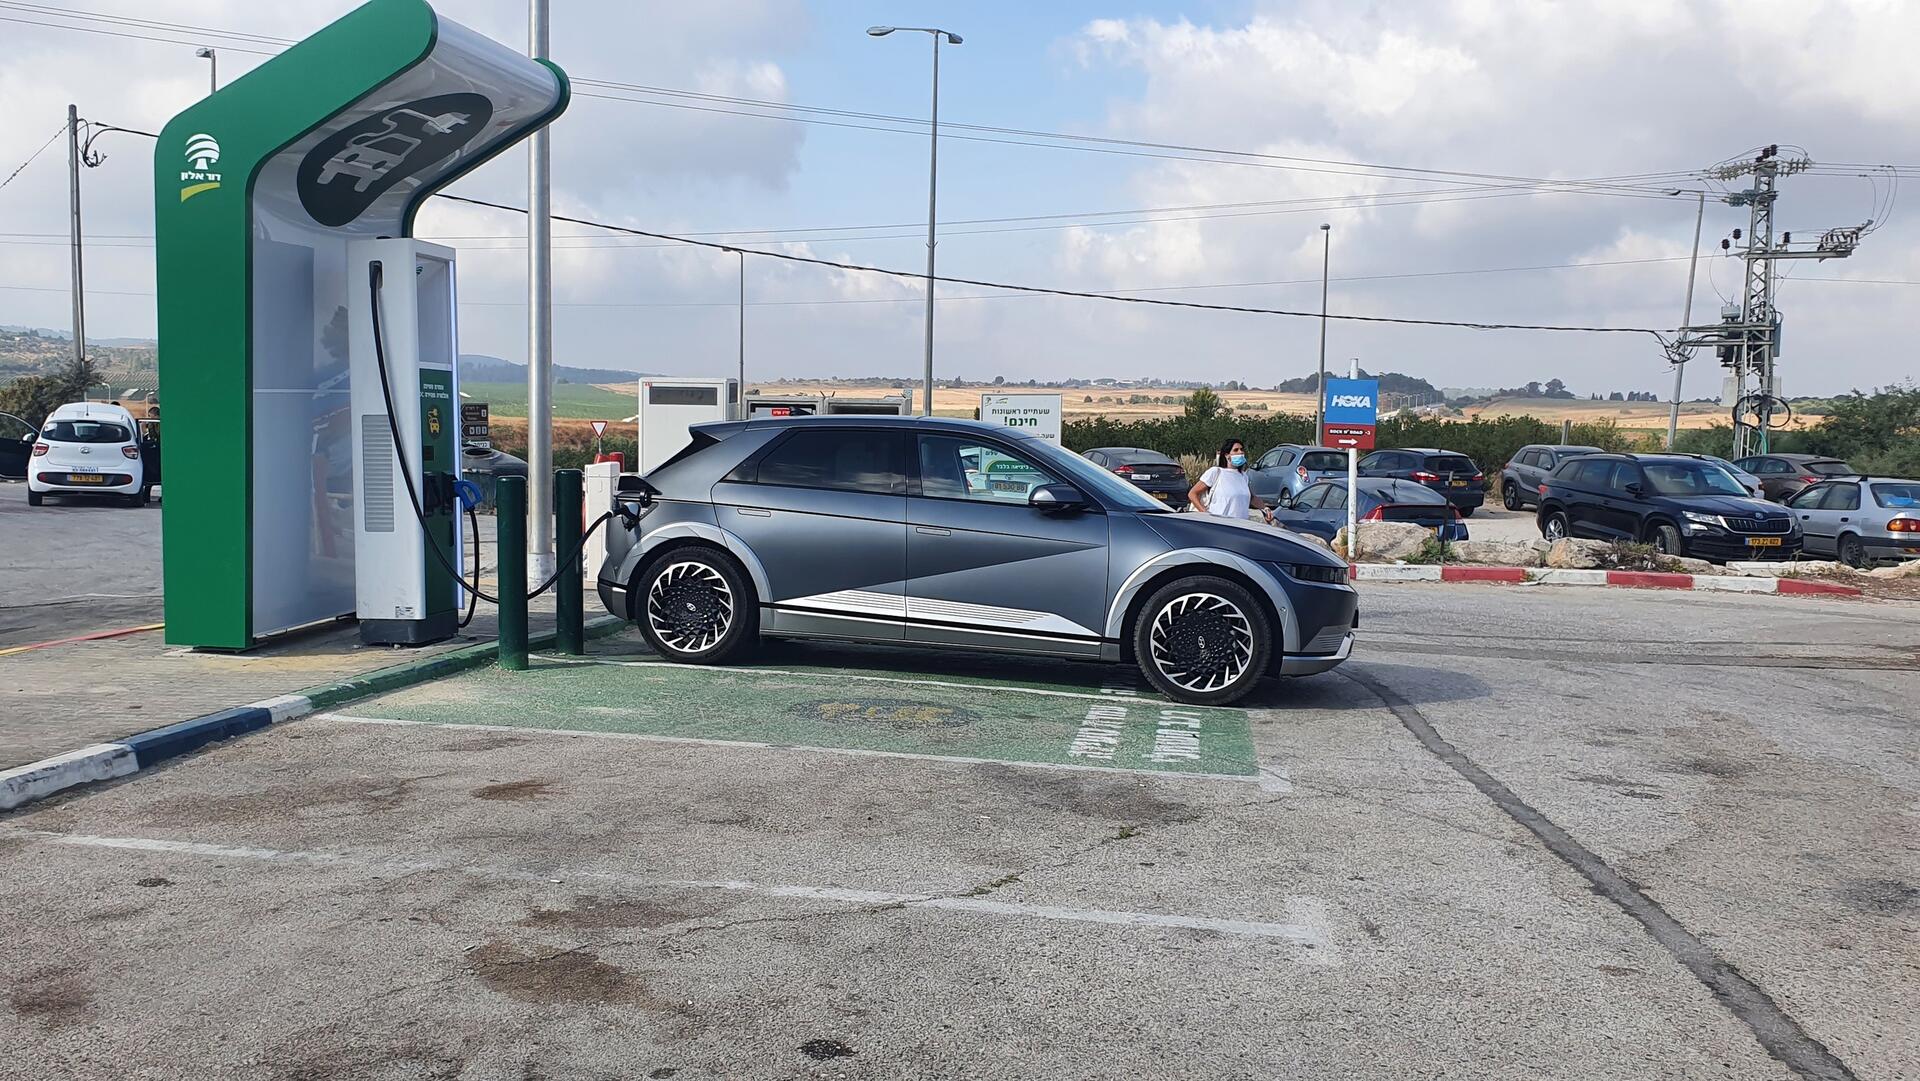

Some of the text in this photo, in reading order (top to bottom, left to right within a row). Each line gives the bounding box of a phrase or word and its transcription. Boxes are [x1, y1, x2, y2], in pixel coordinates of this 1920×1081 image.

[180, 171, 222, 181] דור אלון
[1331, 394, 1371, 408] HOKA
[1004, 416, 1037, 426] חינם!
